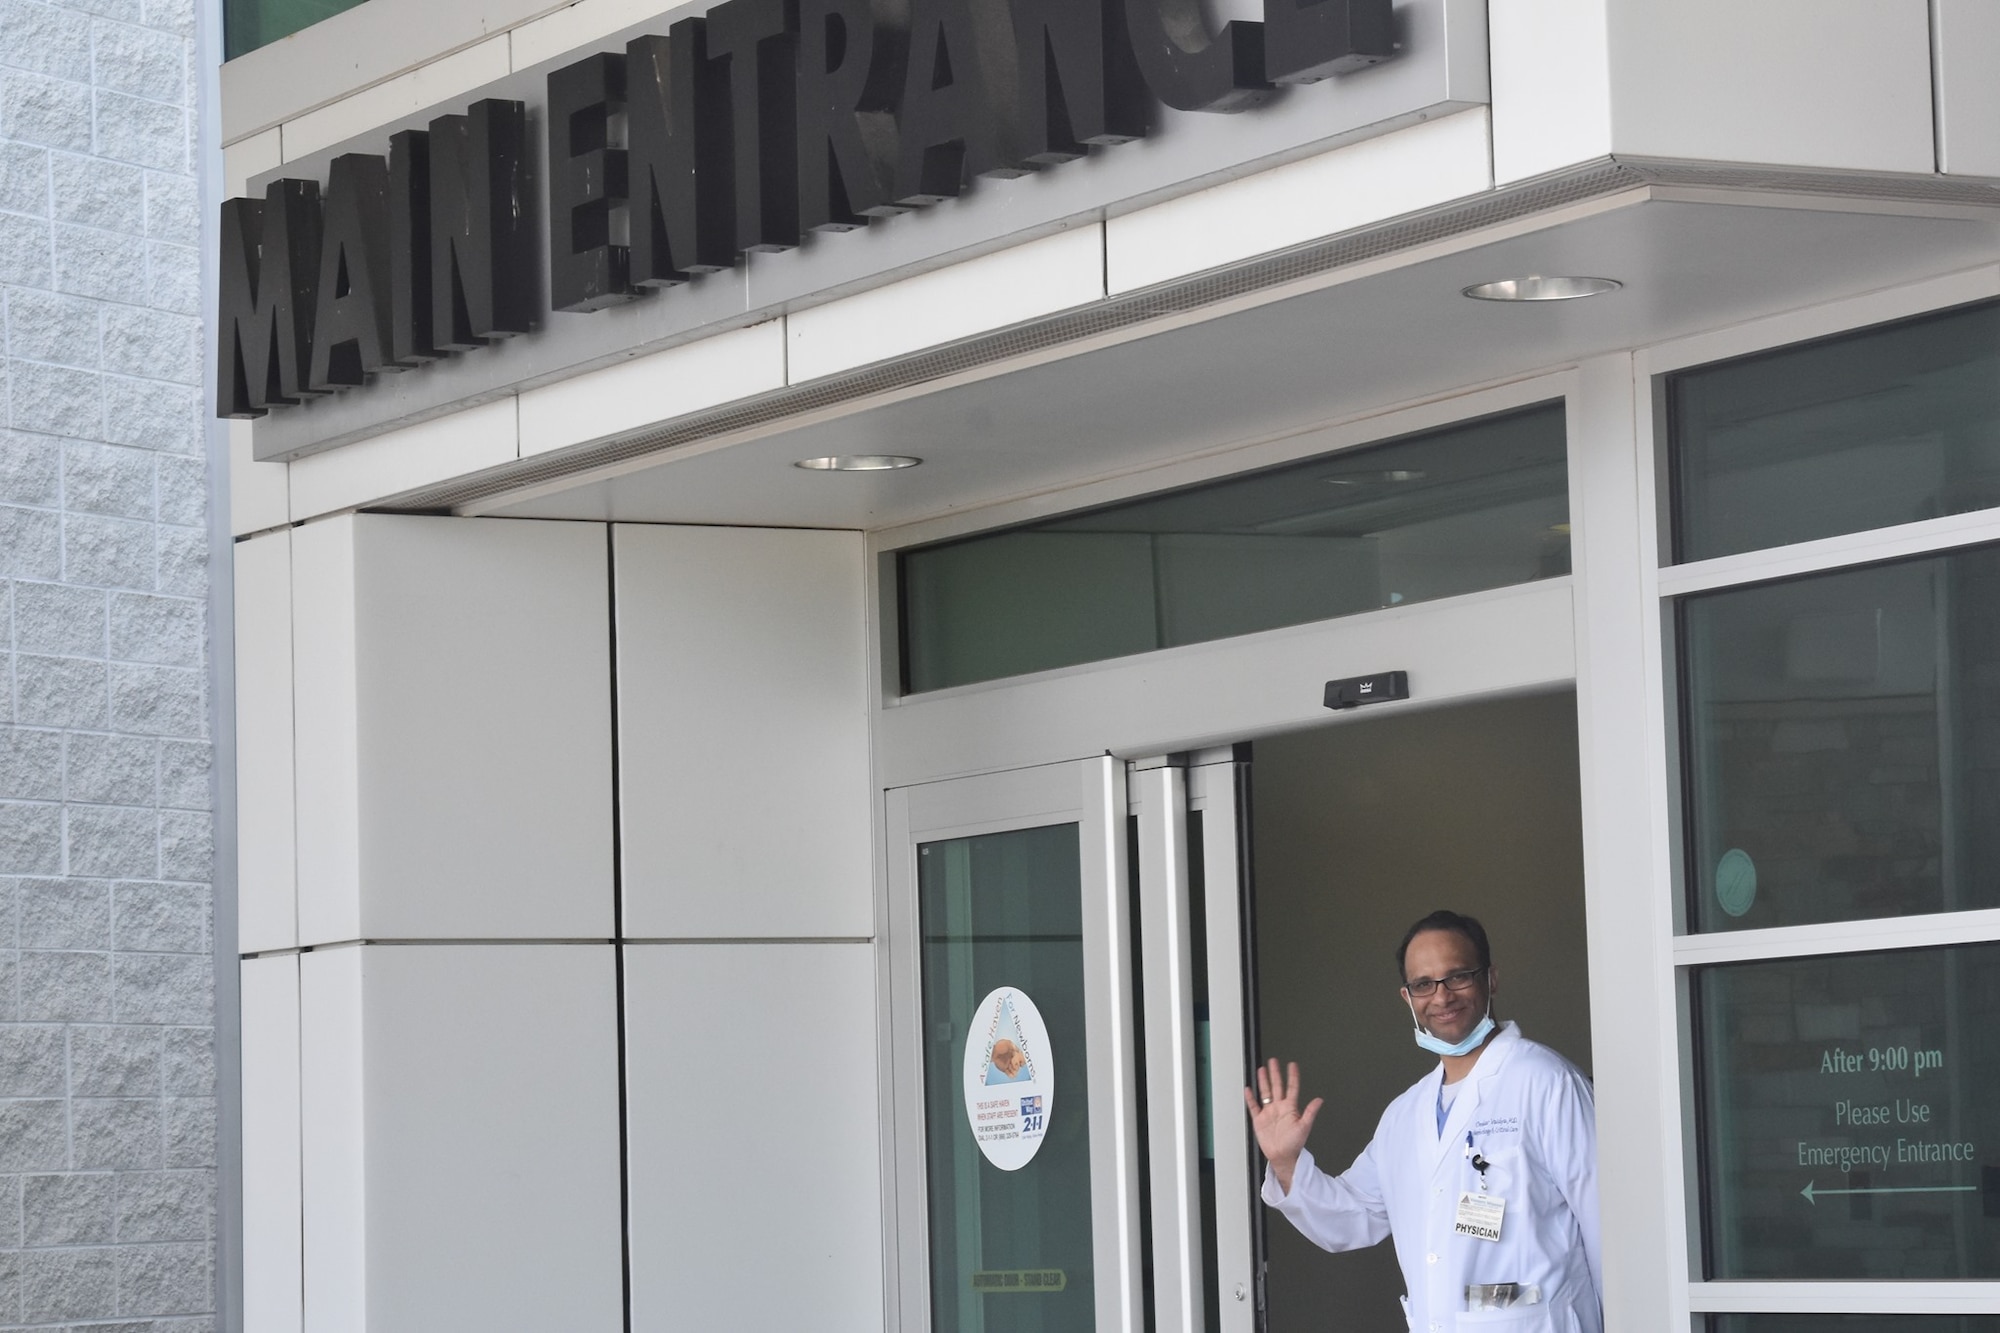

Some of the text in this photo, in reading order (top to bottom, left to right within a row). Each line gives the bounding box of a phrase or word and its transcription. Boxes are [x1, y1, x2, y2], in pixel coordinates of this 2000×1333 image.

[217, 0, 1393, 420] MAIN ENTRAN
[982, 1039, 992, 1072] Safe
[988, 996, 1003, 1039] Haven
[1006, 992, 1037, 1078] For Newborns
[1820, 1046, 1943, 1077] After 9:00 pm
[1835, 1098, 1930, 1126] Please Use
[1798, 1138, 1974, 1173] Emergency Entrance
[1455, 1222, 1499, 1239] PHYSICIAN
